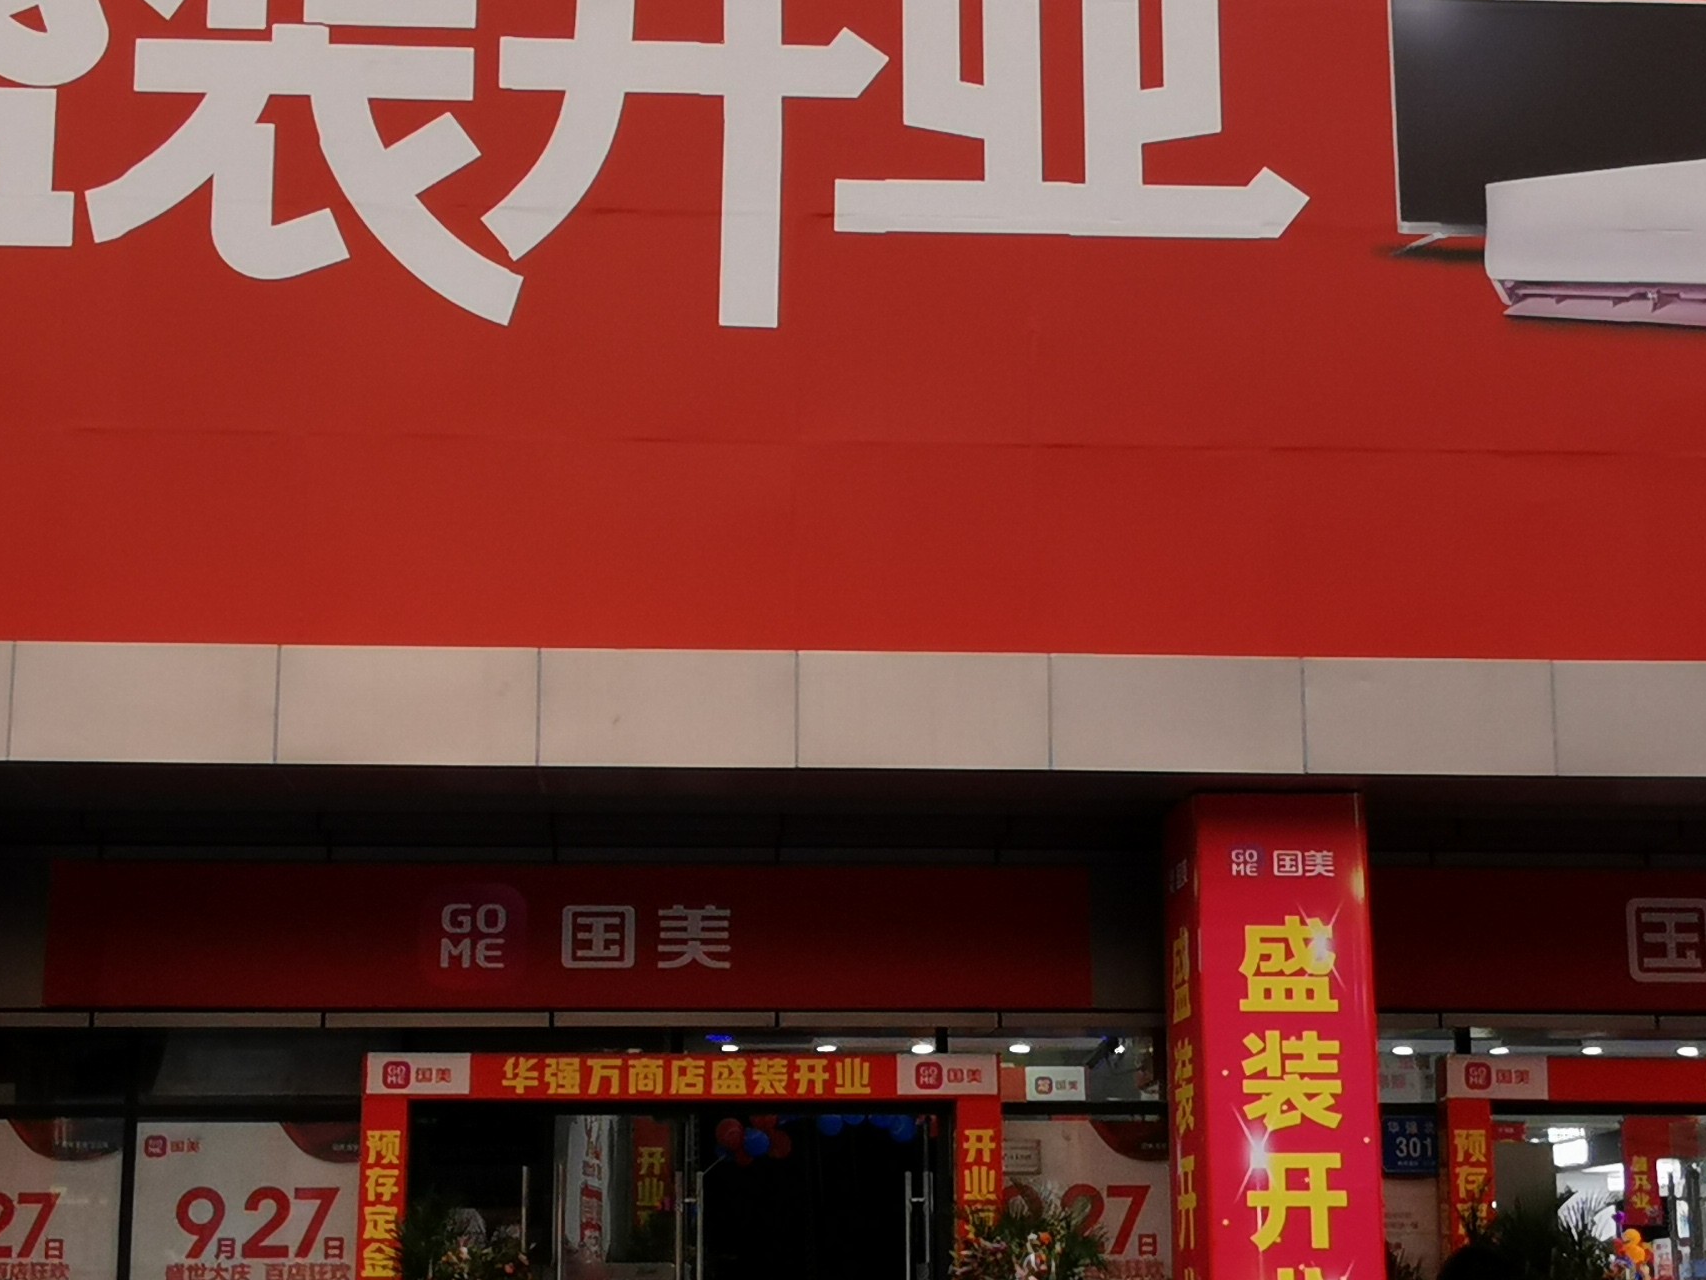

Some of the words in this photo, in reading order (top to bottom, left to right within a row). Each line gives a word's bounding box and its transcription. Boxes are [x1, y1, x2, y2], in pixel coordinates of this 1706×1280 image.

[1273, 850, 1335, 877] 国美
[561, 904, 733, 971] 国美
[415, 1067, 452, 1084] 国美
[501, 1056, 873, 1097] 华强万商店盛装开业
[947, 1067, 983, 1084] 国美
[1496, 1068, 1530, 1085] 国美
[175, 1186, 345, 1261] 9月27日
